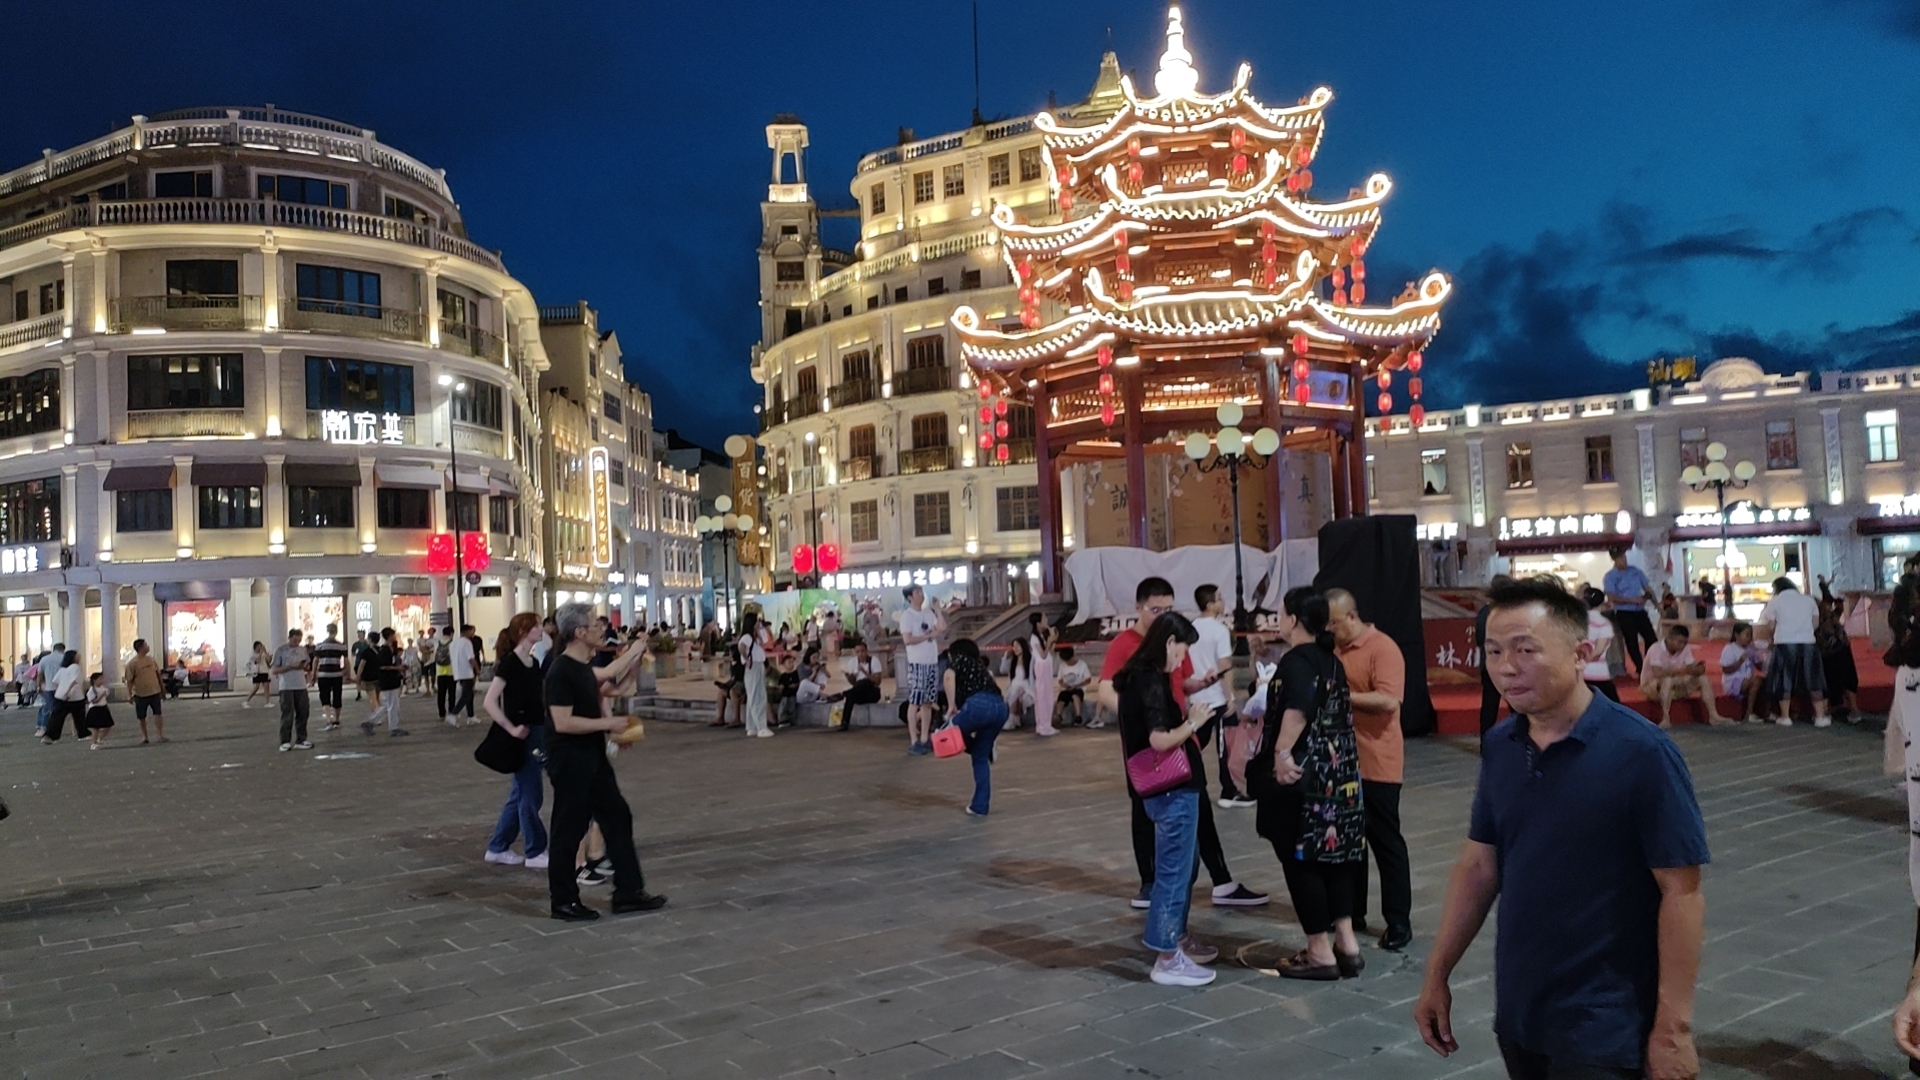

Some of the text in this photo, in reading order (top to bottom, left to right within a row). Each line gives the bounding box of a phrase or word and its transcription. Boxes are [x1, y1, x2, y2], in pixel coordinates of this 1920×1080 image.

[321, 408, 404, 445] 潮宏基
[737, 461, 758, 560] 百货楼
